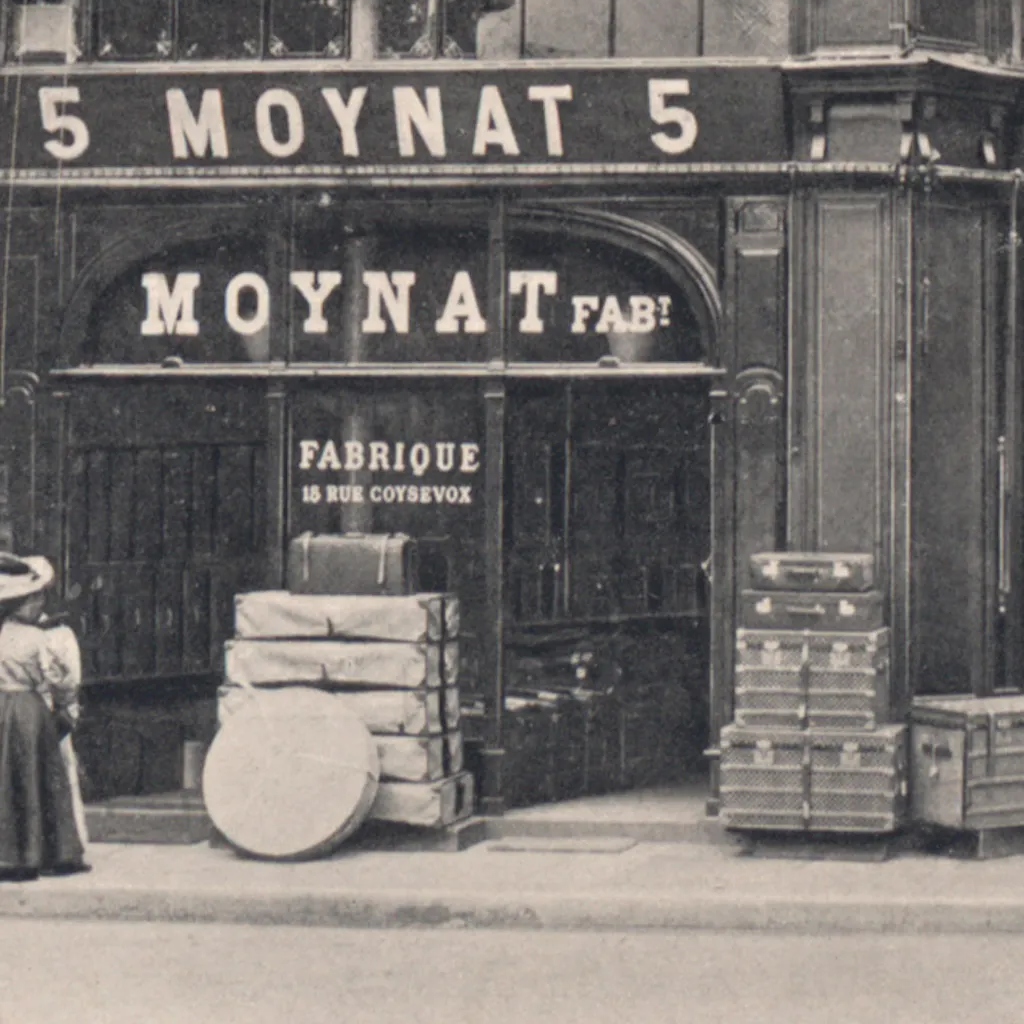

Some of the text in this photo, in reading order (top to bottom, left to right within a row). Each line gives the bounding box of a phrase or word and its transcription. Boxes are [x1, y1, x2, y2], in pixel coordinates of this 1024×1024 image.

[38, 79, 698, 160] 5 MOYNAT 5
[140, 269, 557, 336] MOYNAT
[298, 440, 481, 476] FABRIQUE
[326, 485, 364, 504] RUE
[370, 485, 472, 505] COYSEVOX
